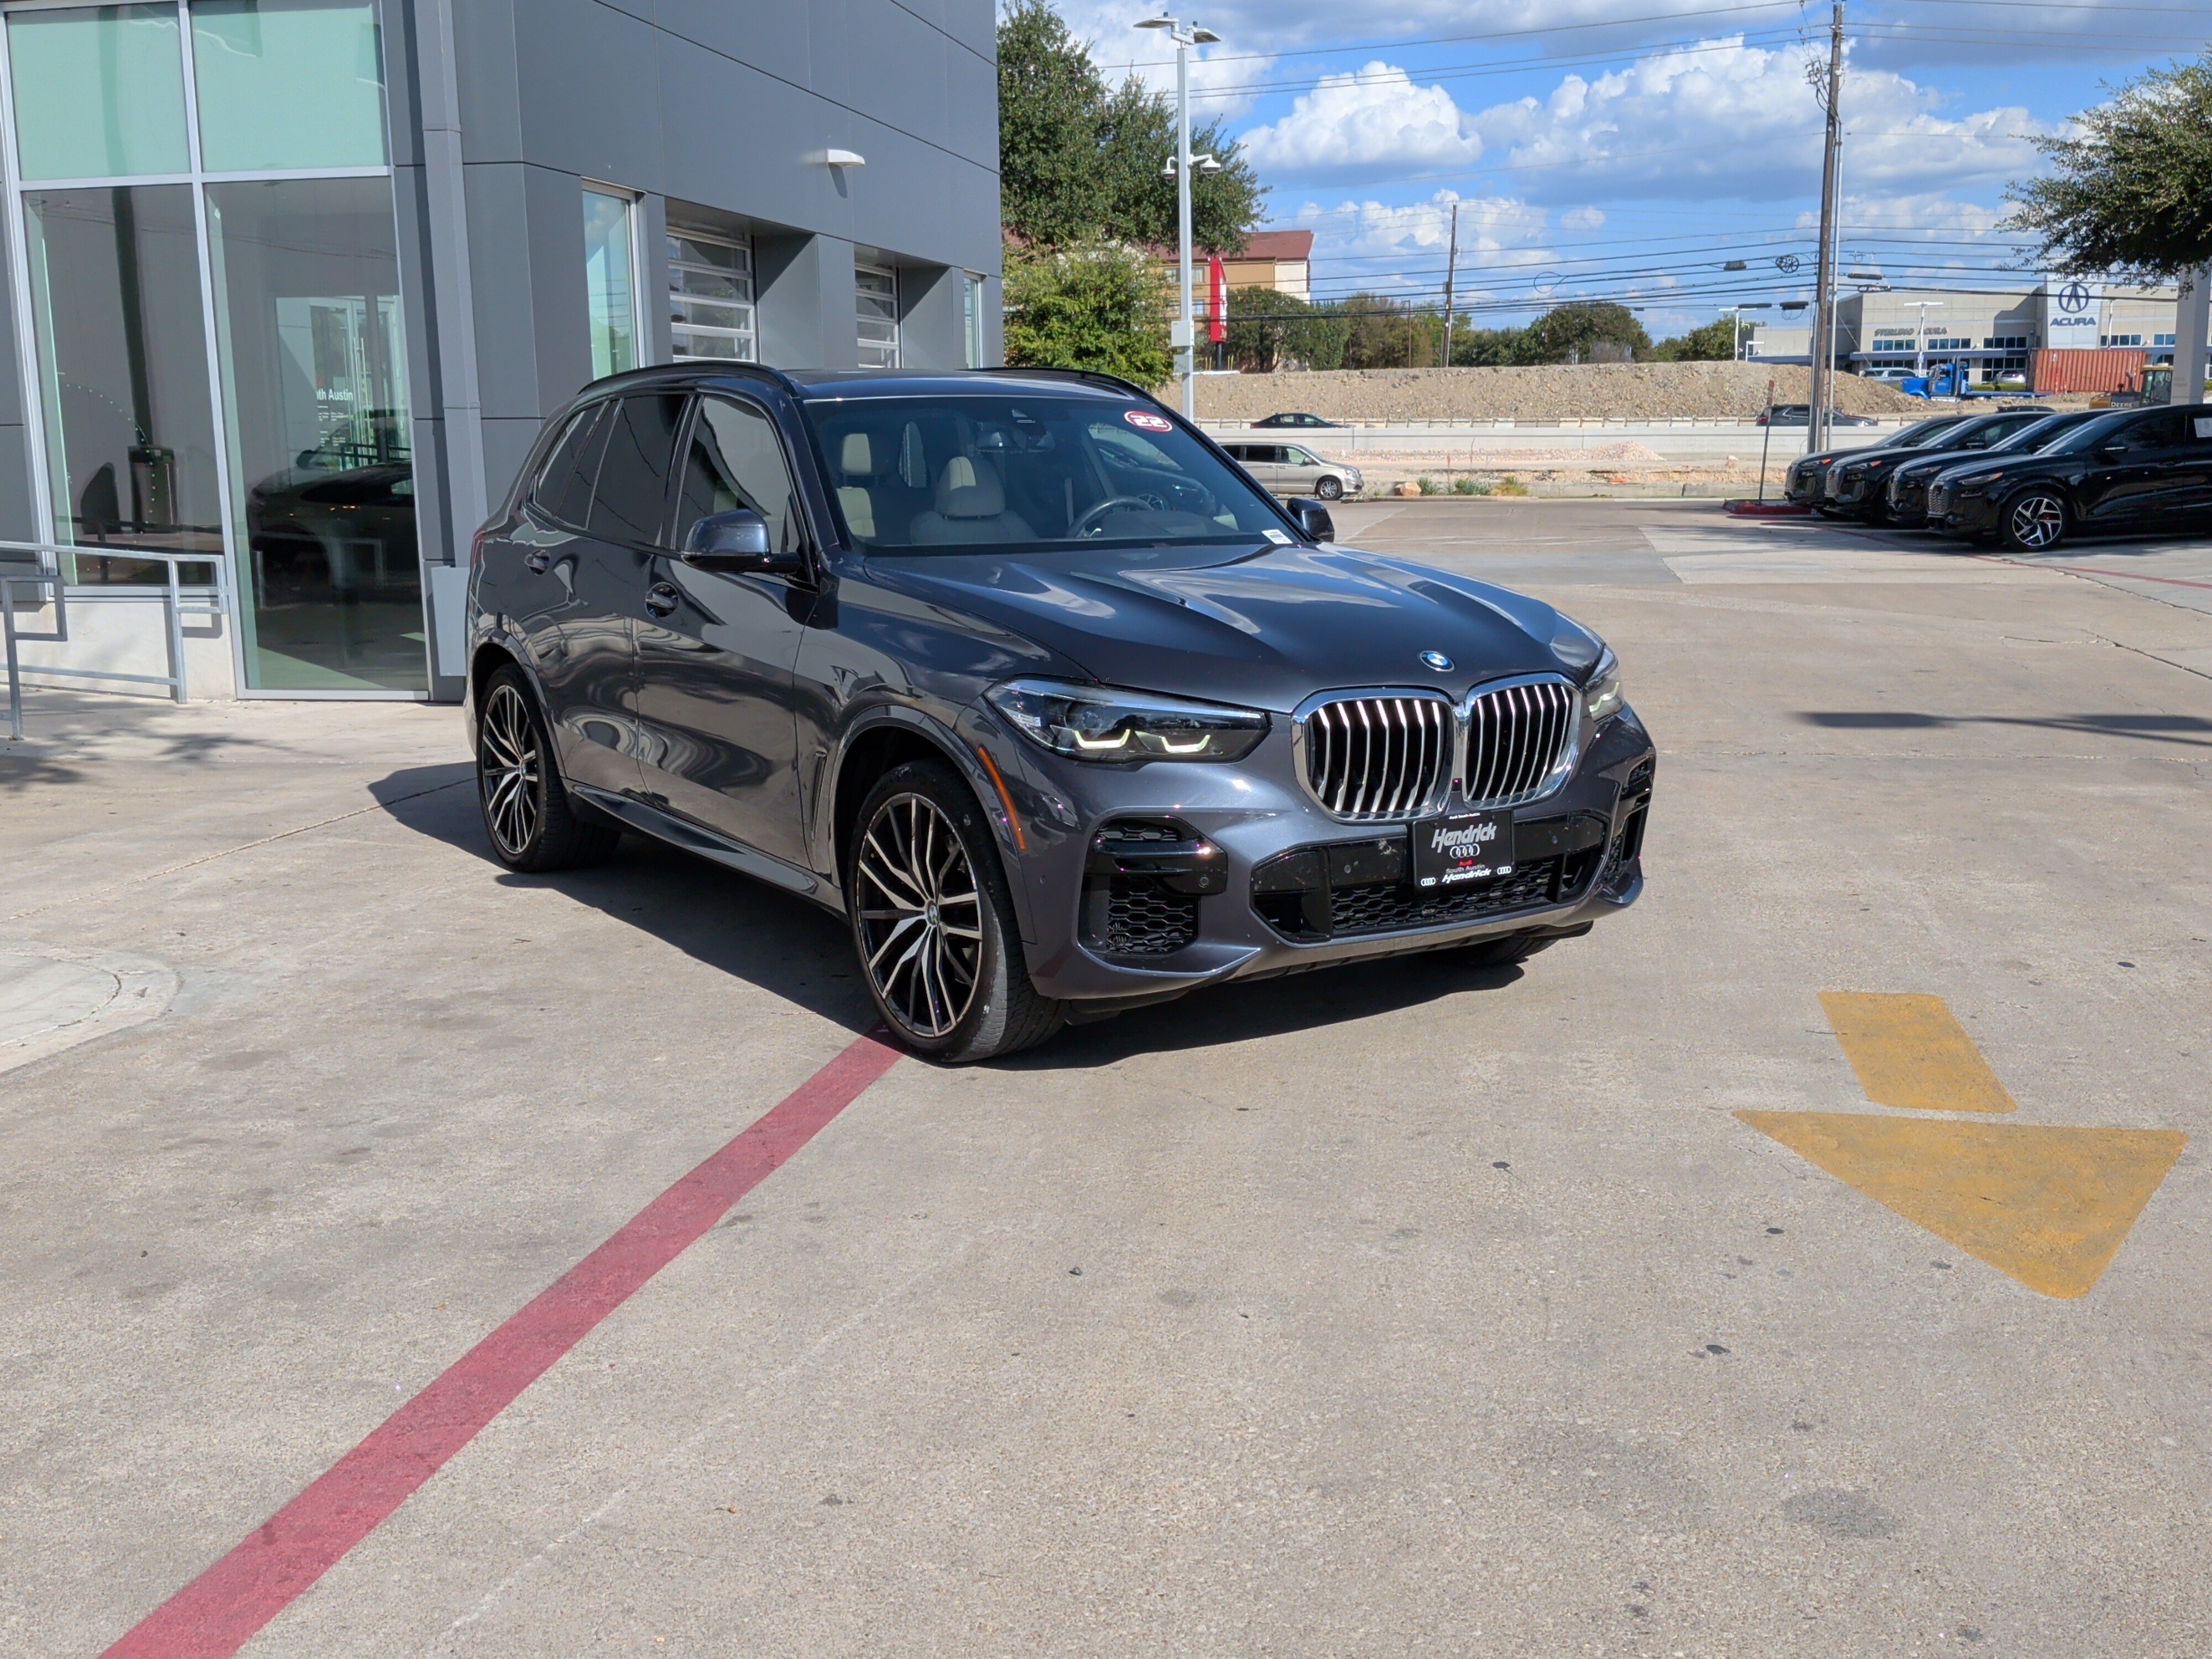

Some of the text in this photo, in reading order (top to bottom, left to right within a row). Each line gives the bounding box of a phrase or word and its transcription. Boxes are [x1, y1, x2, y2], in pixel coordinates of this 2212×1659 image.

[2050, 317, 2096, 327] ACURA
[328, 388, 353, 401] Austin
[1130, 415, 1168, 428] 22
[1431, 822, 1497, 853] Hendrick
[1465, 863, 1485, 872] Austin
[1441, 868, 1492, 884] Hendrick
